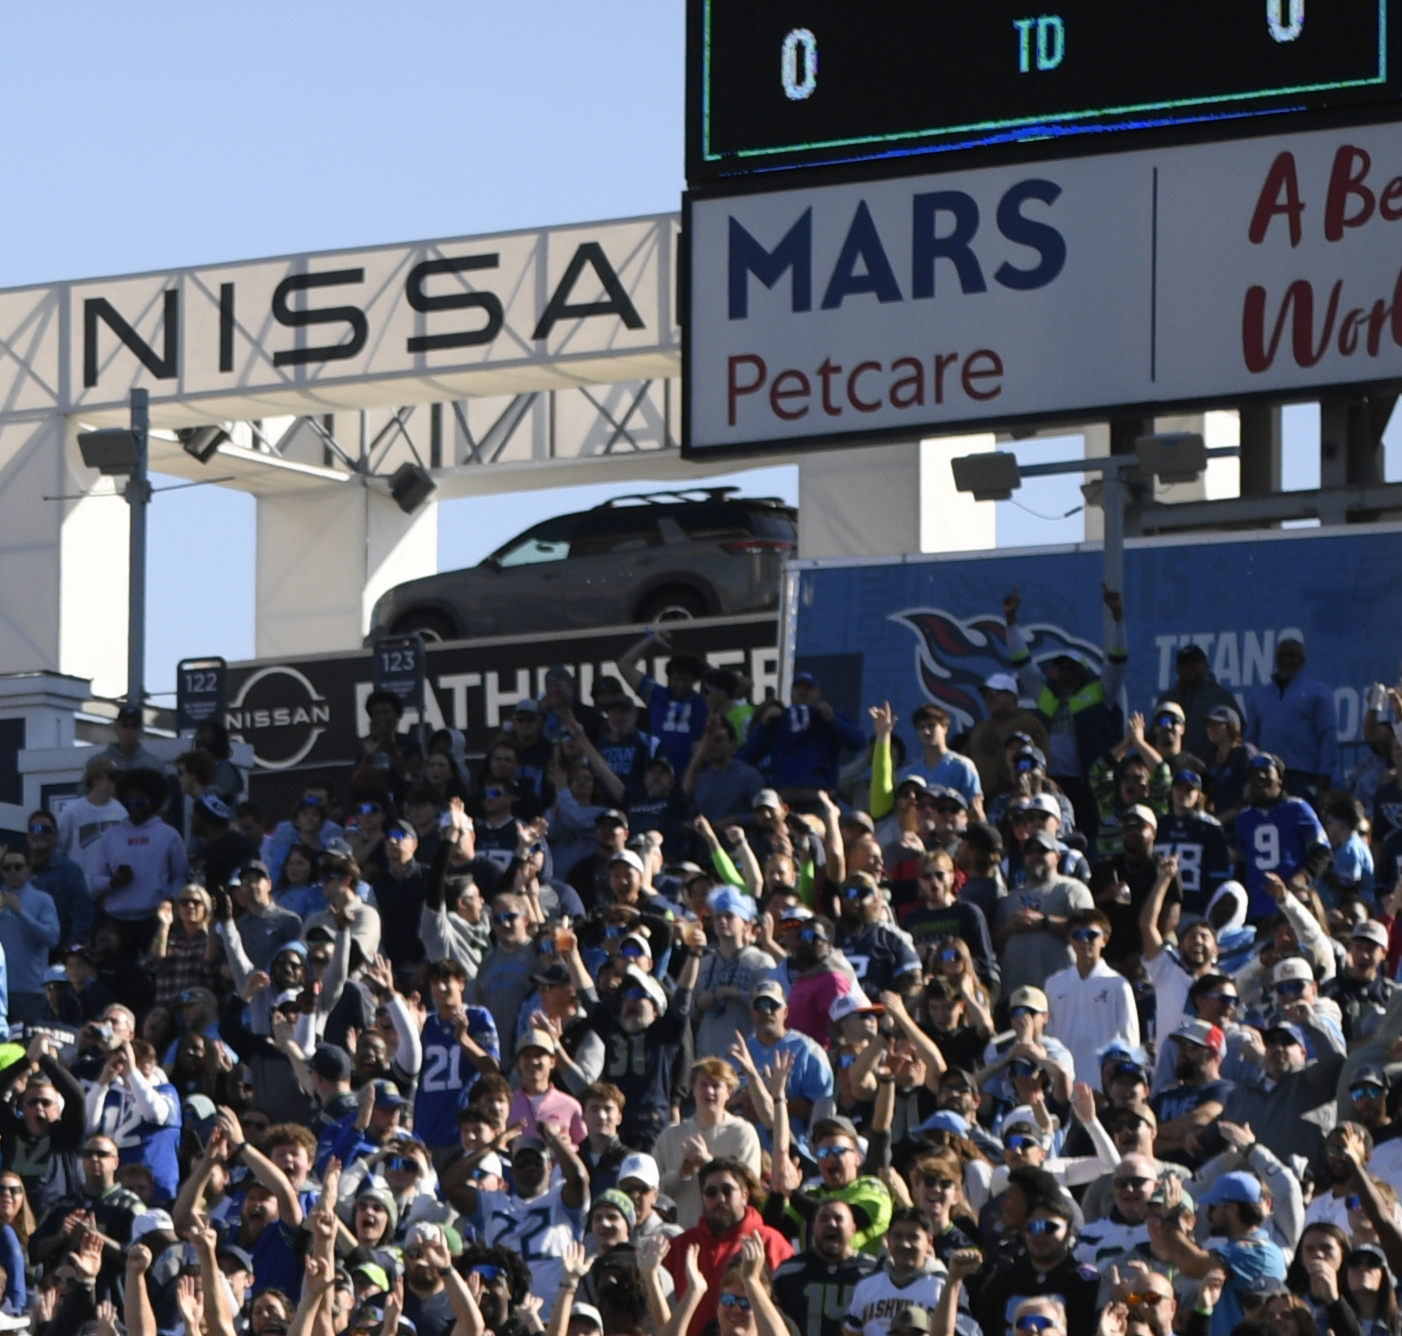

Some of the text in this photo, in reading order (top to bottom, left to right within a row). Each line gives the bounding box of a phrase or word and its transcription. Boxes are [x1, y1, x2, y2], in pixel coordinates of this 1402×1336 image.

[781, 28, 817, 100] 0
[1013, 14, 1066, 74] TD
[1248, 150, 1306, 247] A
[728, 178, 1067, 321] MARS
[84, 233, 682, 388] NISSA
[727, 348, 1004, 427] Petcare
[185, 672, 217, 693] 122
[382, 650, 415, 672] 123
[1156, 627, 1304, 692] TITAN
[226, 704, 330, 728] NISSAN
[1254, 823, 1280, 871] 9
[423, 1044, 463, 1093] 21
